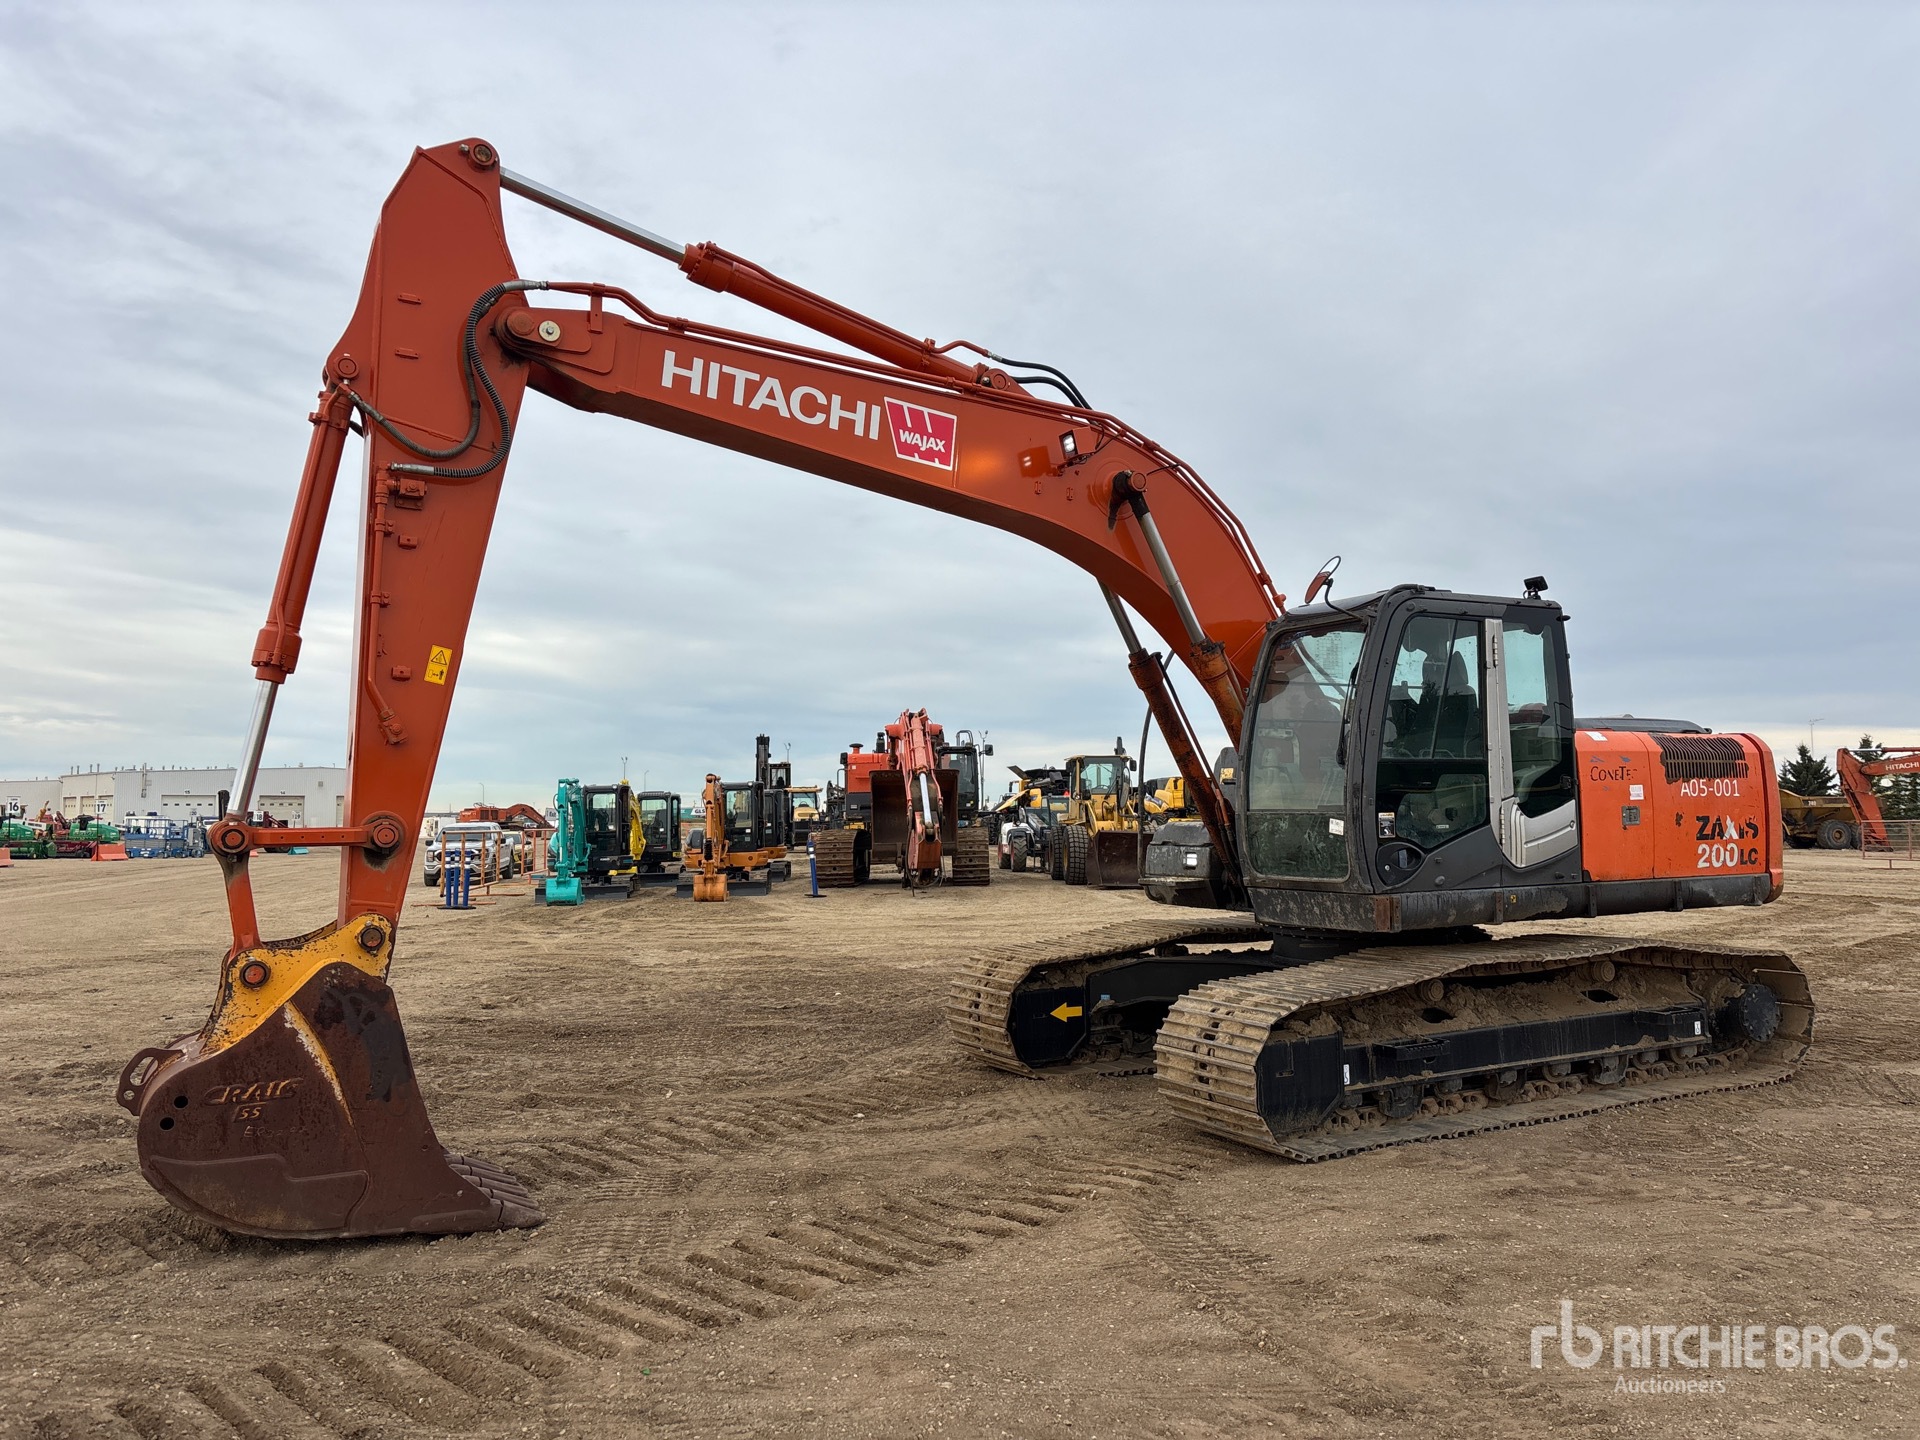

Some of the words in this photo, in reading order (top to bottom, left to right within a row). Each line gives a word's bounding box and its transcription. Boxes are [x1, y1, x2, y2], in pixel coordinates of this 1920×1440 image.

[661, 350, 881, 440] HITACHI
[899, 429, 946, 453] WAJAX
[1885, 762, 1920, 771] HITACHI
[1680, 779, 1740, 797] A05-001
[9, 802, 20, 812] 16
[97, 803, 107, 813] 17
[256, 813, 263, 821] 18
[1696, 815, 1759, 841] ZAXIS
